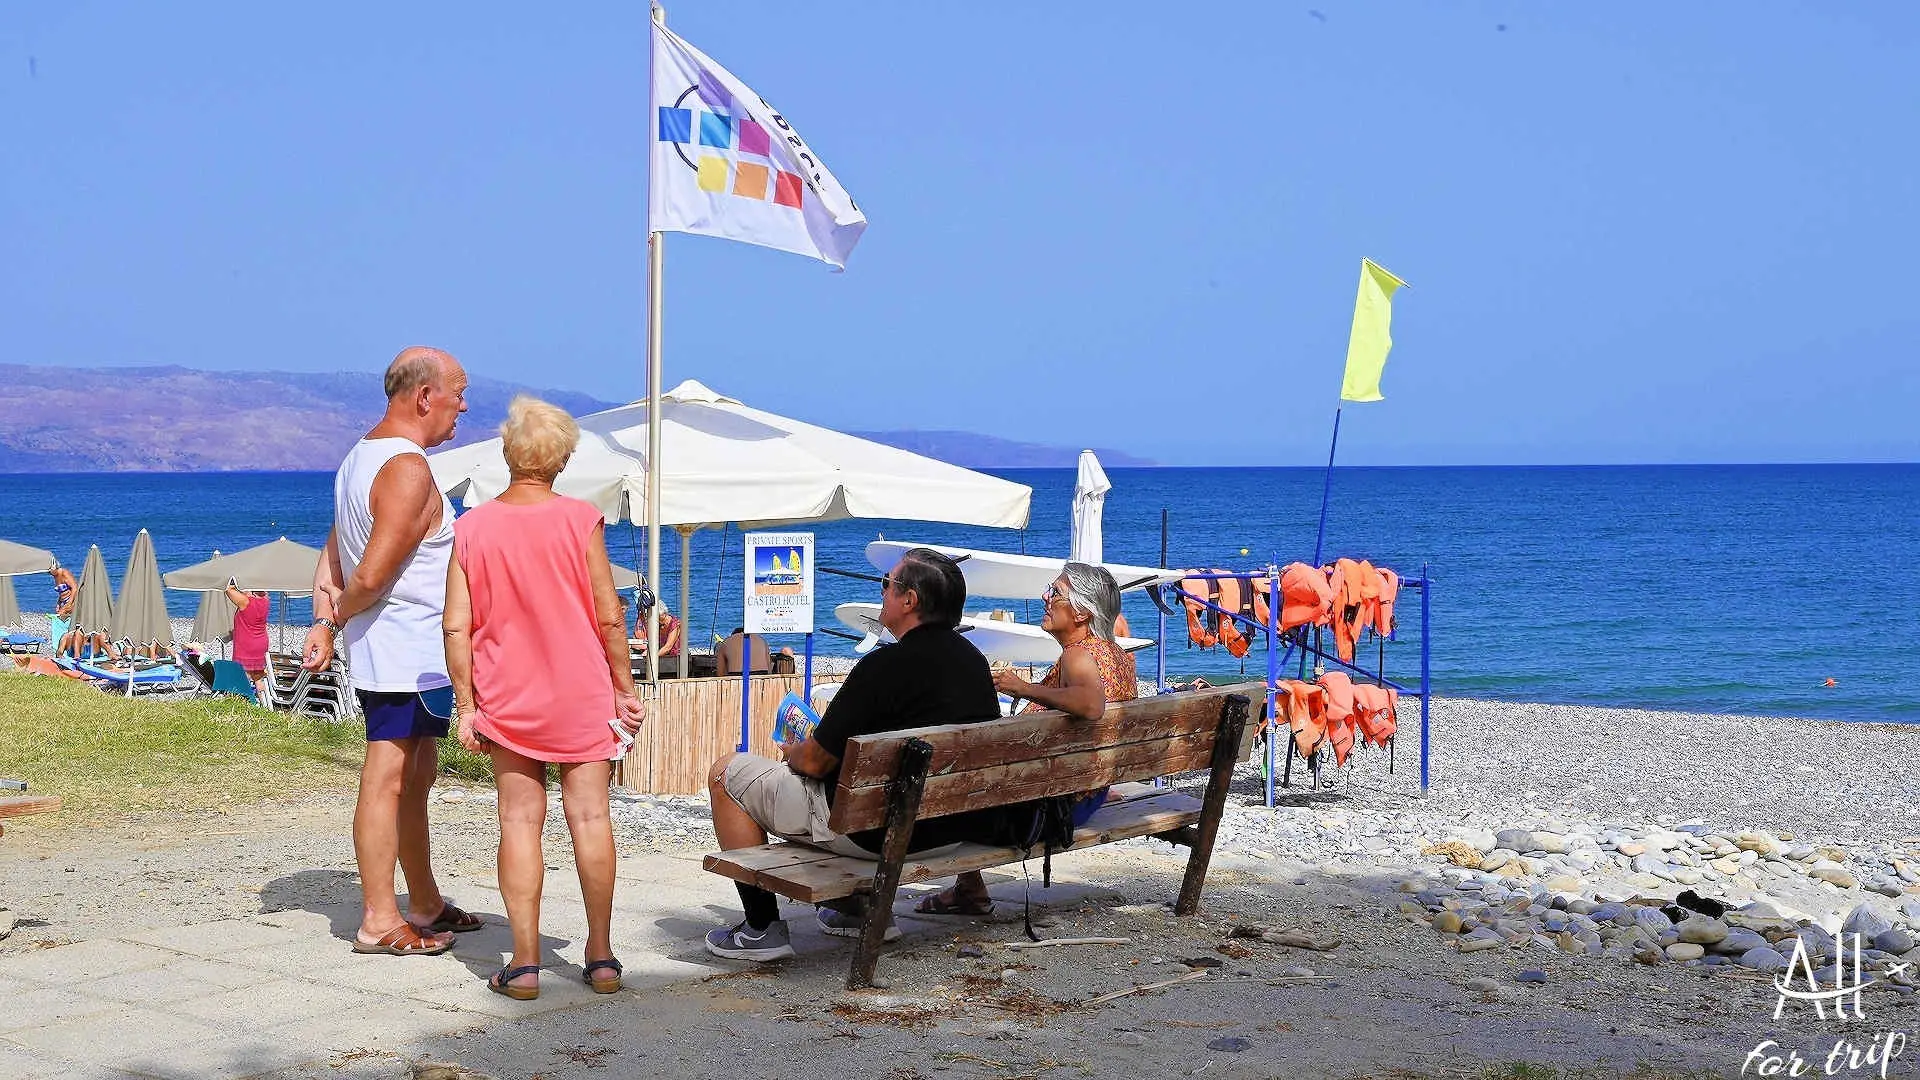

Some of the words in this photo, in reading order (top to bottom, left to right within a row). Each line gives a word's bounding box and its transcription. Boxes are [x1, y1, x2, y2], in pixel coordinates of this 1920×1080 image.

[747, 535, 781, 545] PRIVATE
[782, 535, 813, 545] SPORTS
[747, 595, 781, 606] CASTRO
[783, 595, 810, 605] HOTEL
